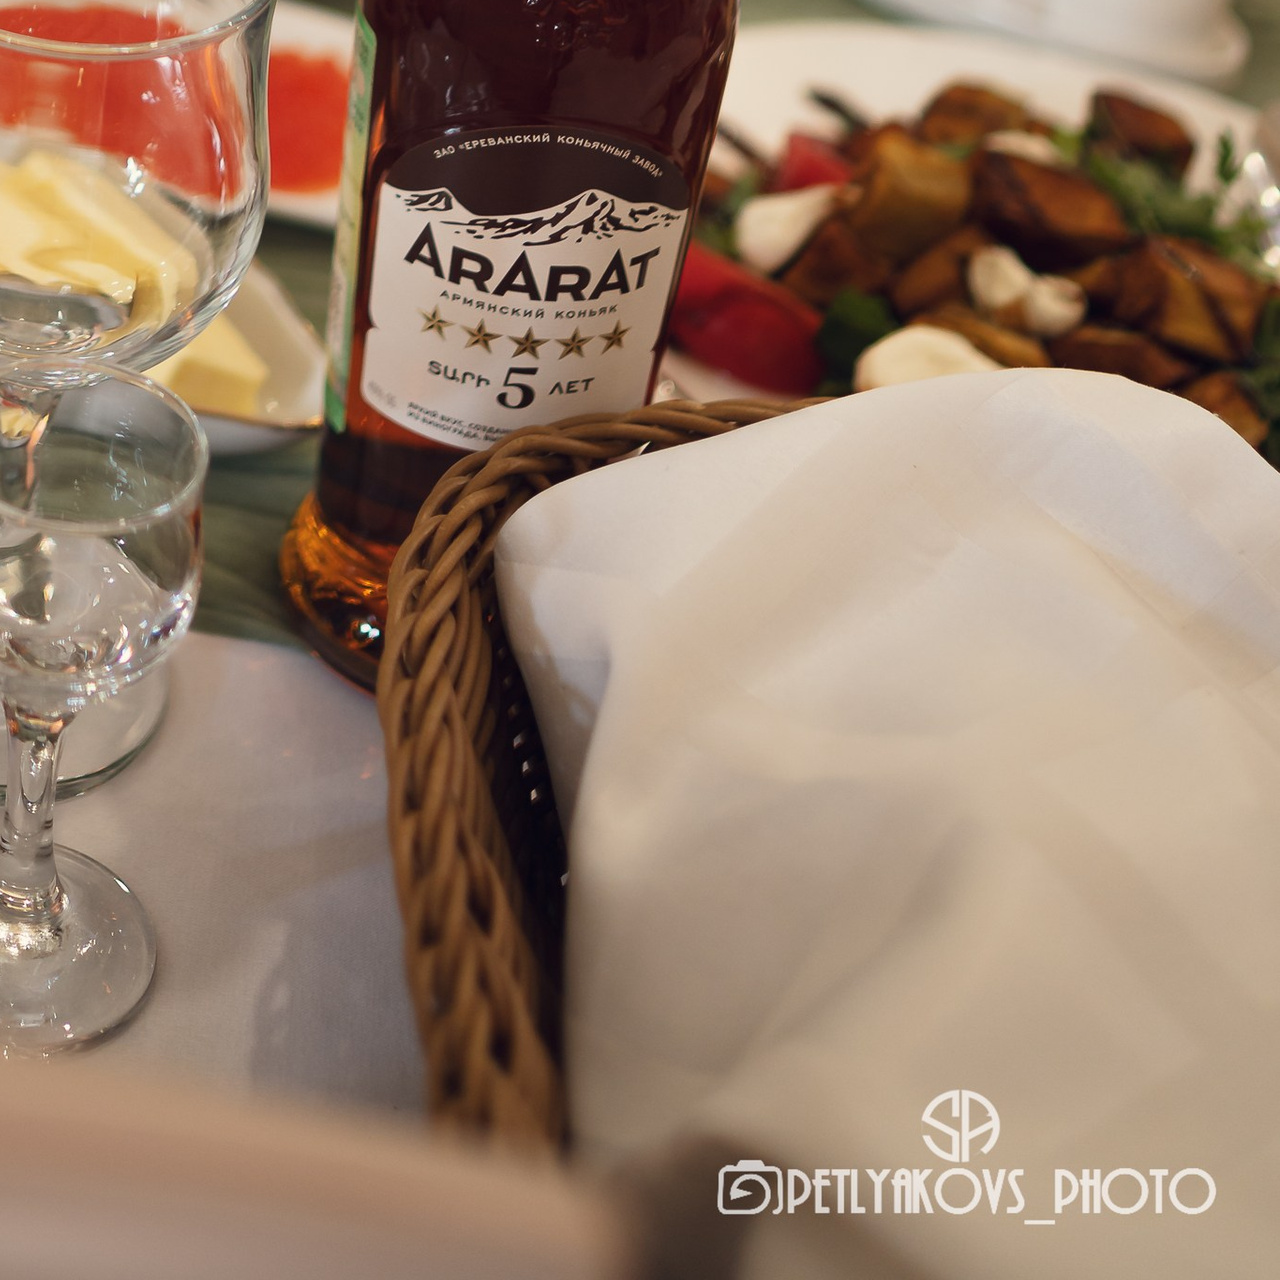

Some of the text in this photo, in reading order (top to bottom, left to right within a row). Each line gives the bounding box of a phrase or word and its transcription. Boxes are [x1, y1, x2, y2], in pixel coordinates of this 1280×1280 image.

[433, 144, 456, 159] ЗАО
[458, 132, 550, 151] «ЕРЕВАНСКИЙ
[556, 134, 631, 160] КОНЬЯЧНЫЙ
[403, 221, 661, 303] ARARAT
[439, 289, 618, 320] АРМЯНСКИЙ КОНЬЯК
[496, 367, 539, 410] 5
[548, 377, 595, 396] ЛЕТ
